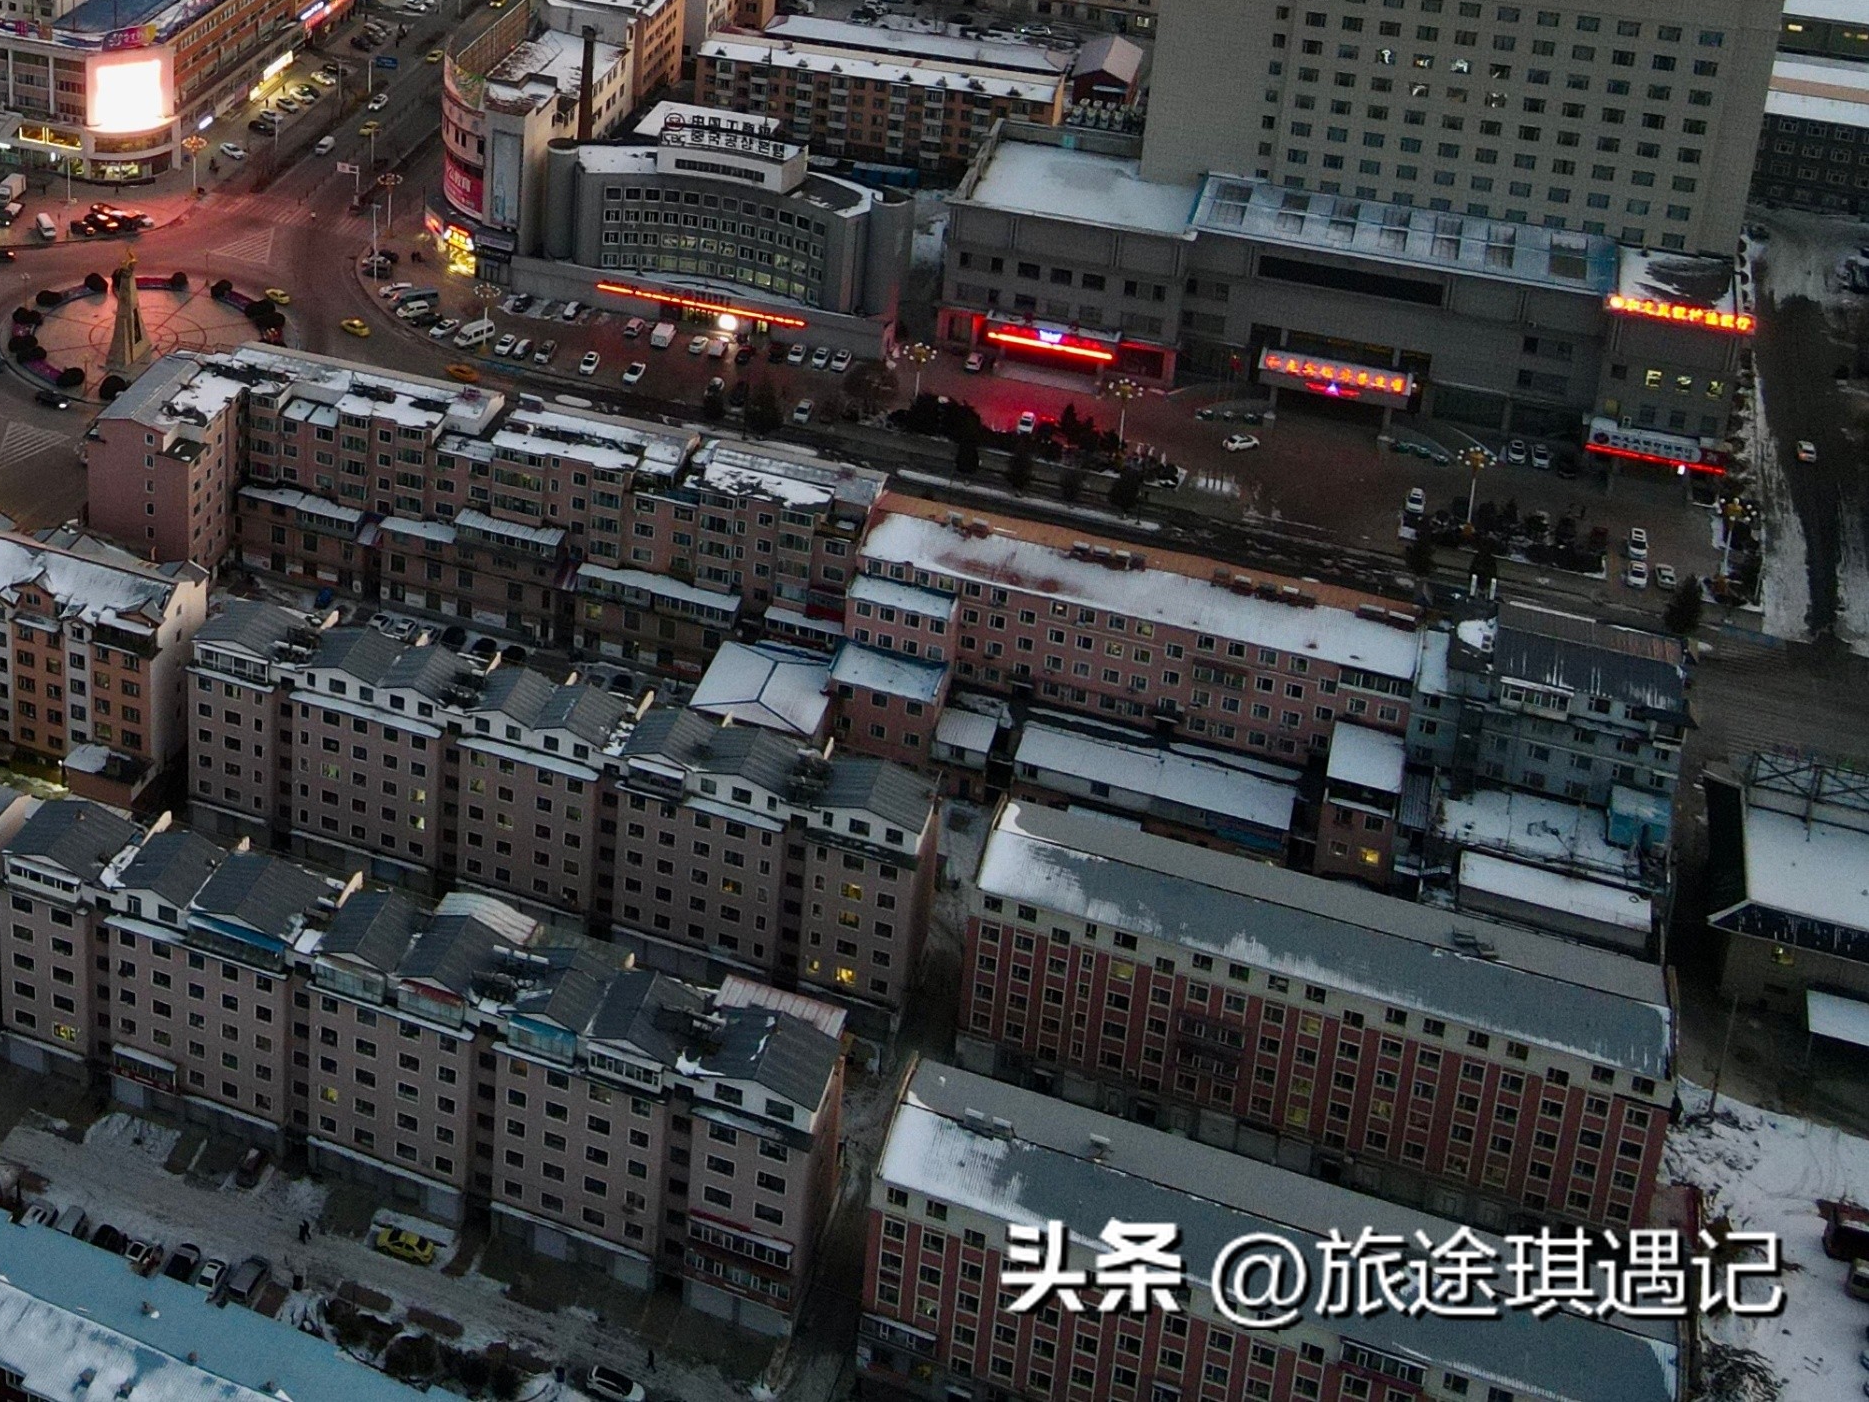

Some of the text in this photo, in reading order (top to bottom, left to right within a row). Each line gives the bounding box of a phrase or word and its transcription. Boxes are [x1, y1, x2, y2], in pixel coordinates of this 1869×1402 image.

[691, 115, 772, 136] 中国工商银
